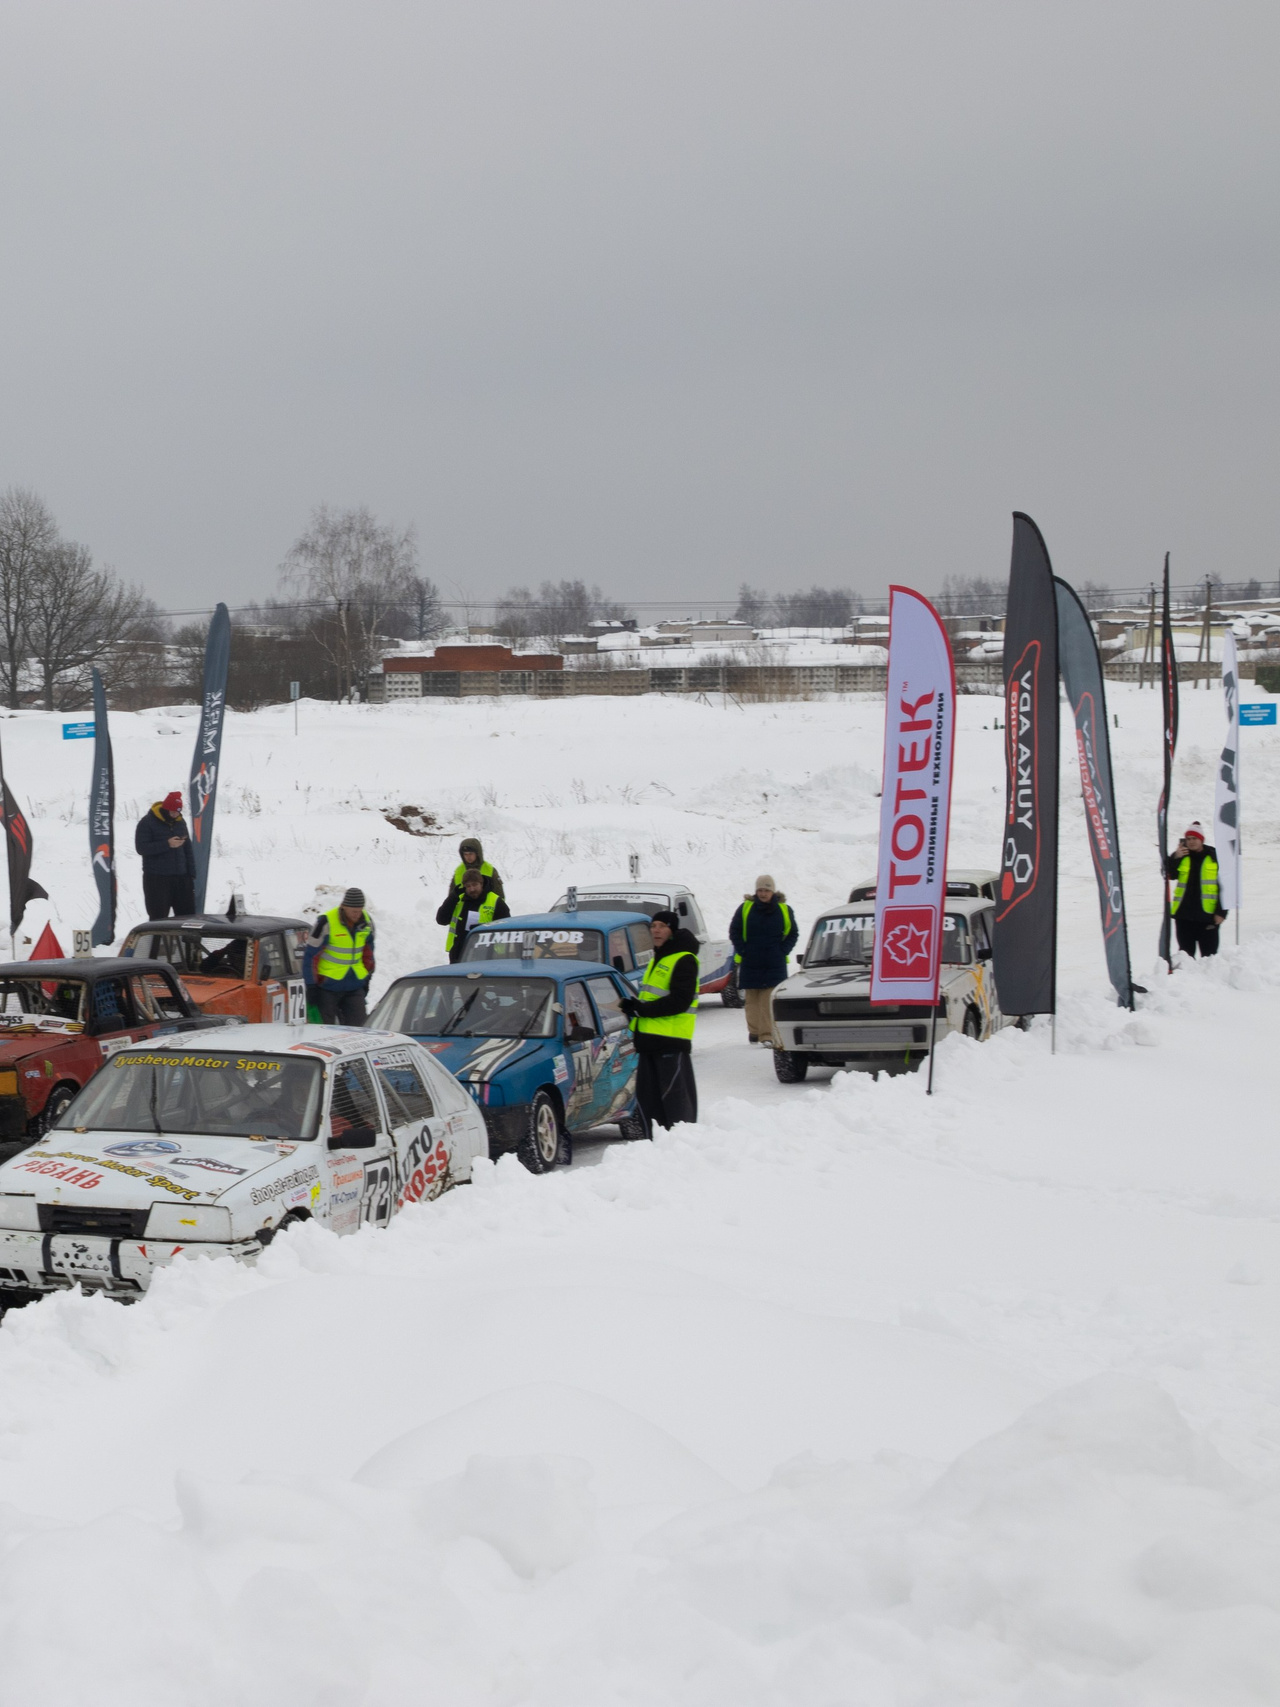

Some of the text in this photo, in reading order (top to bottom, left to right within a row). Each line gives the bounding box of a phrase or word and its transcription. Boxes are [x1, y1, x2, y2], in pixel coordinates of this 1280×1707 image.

[888, 686, 935, 899] TOTEK
[926, 693, 944, 884] ТОПЛИВНЫЕ ТЕХНОЛОГИИ
[76, 931, 90, 952] 95
[474, 931, 584, 948] ДМИРОВ
[290, 984, 304, 1019] 72
[114, 1054, 180, 1068] Tyushevo
[181, 1056, 230, 1069] Motor
[177, 1158, 240, 1174] KRAMAR
[146, 1175, 201, 1200] Sport
[365, 1167, 390, 1222] 72
